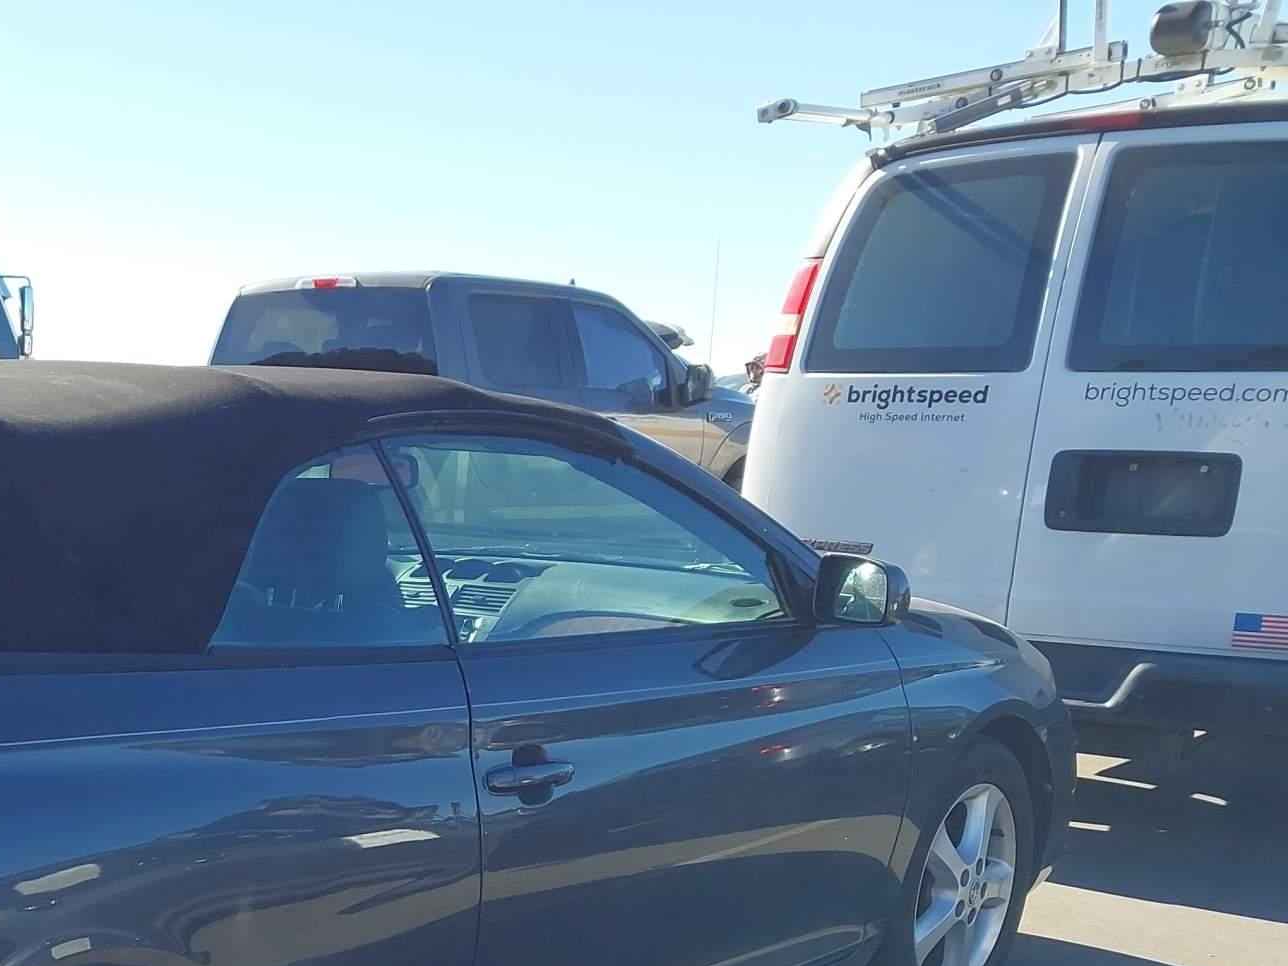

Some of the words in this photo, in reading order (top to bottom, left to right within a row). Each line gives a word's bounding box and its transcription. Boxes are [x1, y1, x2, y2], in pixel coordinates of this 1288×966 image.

[847, 384, 990, 410] brightspeed
[859, 412, 882, 424] High
[885, 412, 918, 423] Speed
[920, 412, 965, 422] Internet
